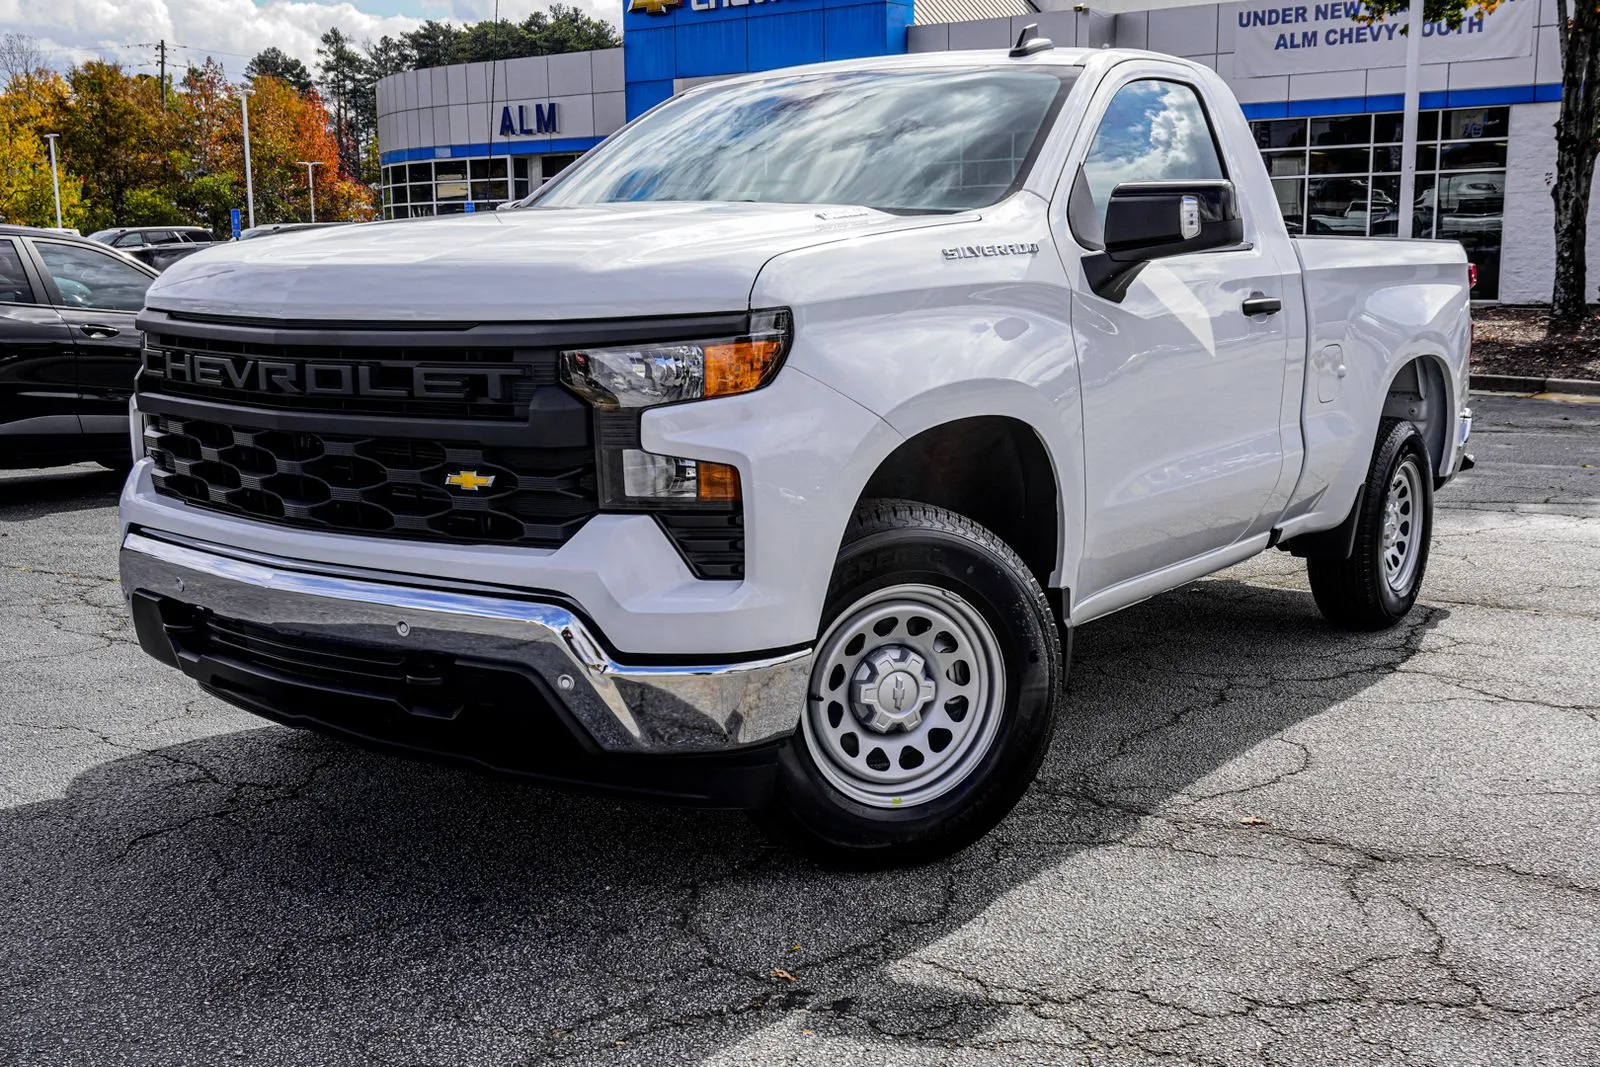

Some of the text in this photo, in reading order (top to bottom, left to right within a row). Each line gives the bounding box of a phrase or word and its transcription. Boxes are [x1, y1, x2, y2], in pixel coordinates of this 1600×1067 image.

[1238, 5, 1308, 28] UNDER
[1314, 0, 1361, 25] NEW
[1274, 15, 1484, 50] ALM CHEVY OUTH
[500, 102, 560, 136] ALM
[942, 242, 1039, 260] SILVERADO
[140, 347, 526, 400] CHEVROLET
